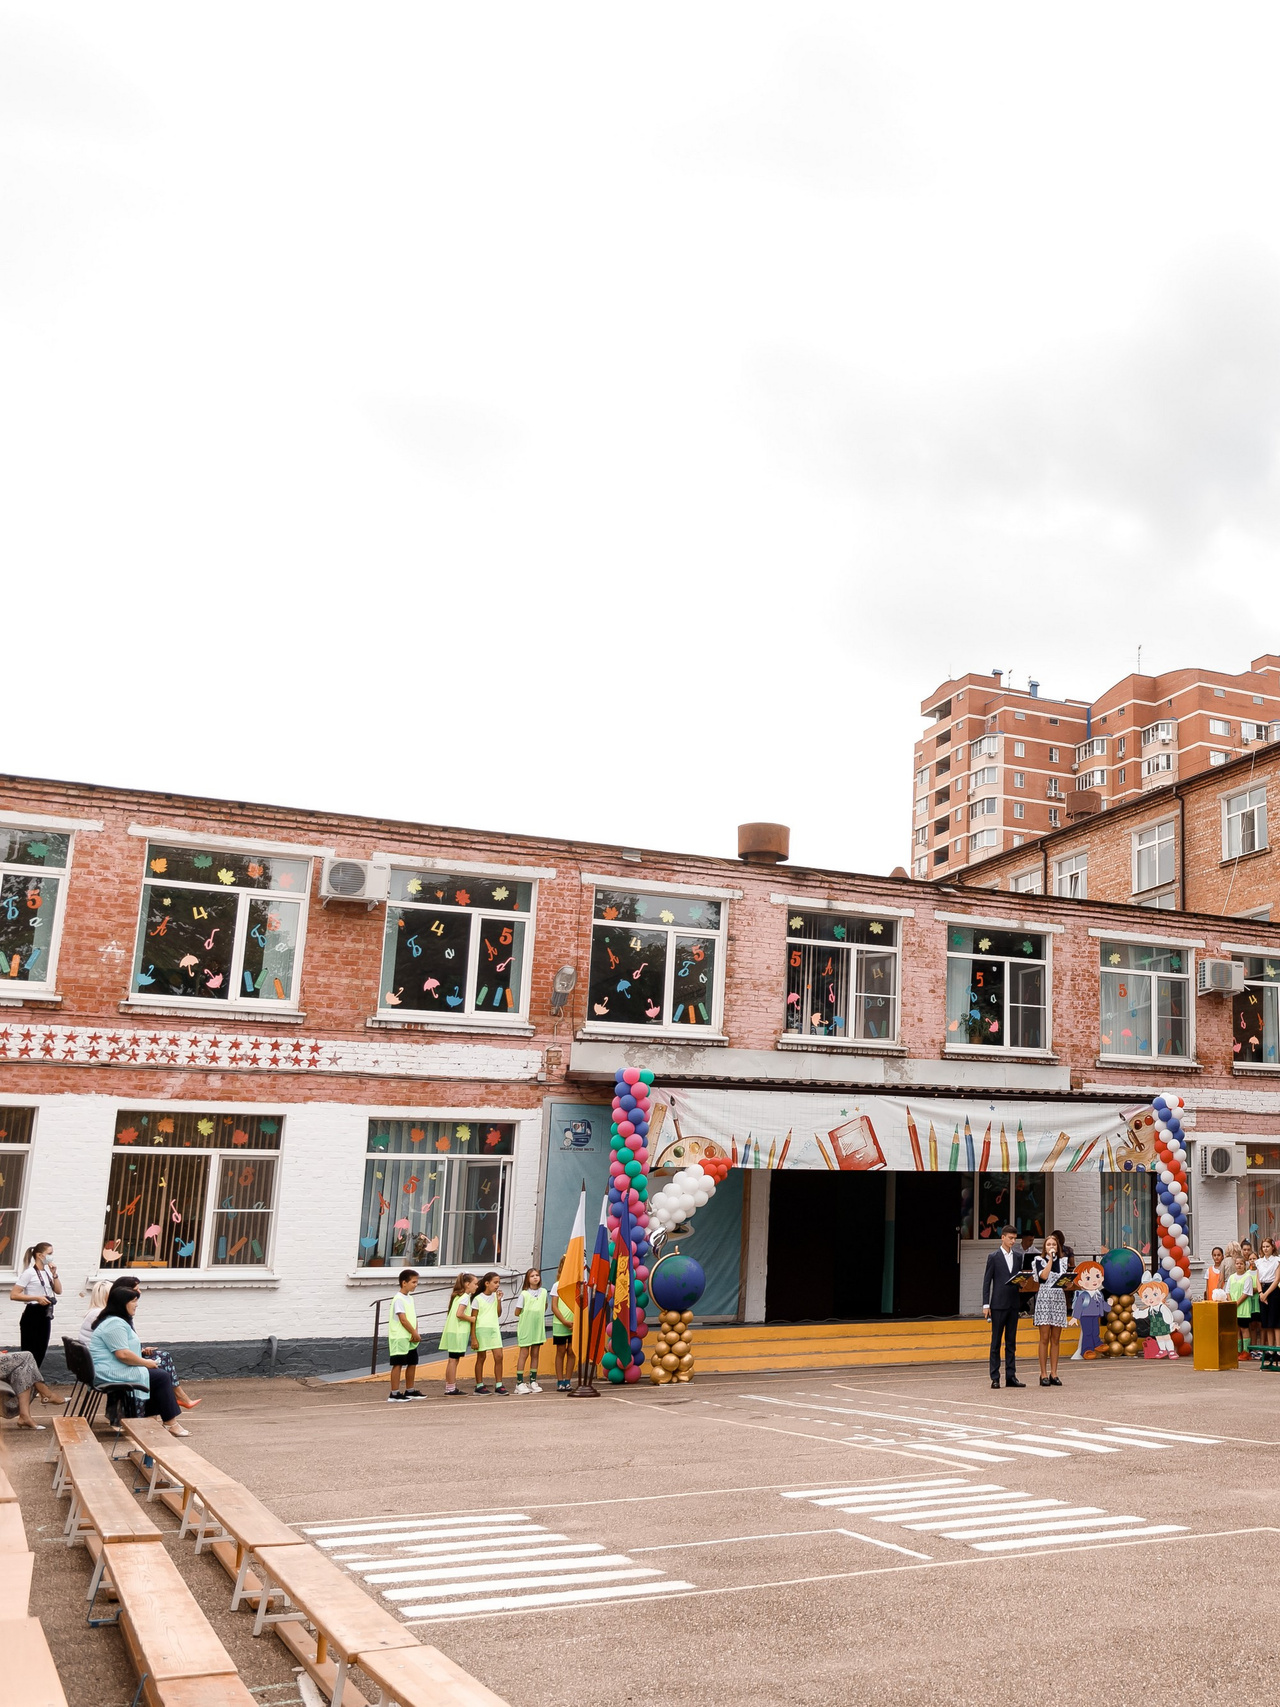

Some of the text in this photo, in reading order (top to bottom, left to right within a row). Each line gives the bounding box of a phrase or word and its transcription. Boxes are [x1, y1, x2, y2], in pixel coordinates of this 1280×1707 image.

[27, 889, 43, 909] 5
[192, 906, 209, 920] 4
[431, 920, 445, 936] 4
[500, 927, 513, 945] 5
[629, 937, 642, 952] 4
[691, 945, 705, 961] 5
[790, 951, 801, 967] 5
[1118, 984, 1127, 997] 5
[403, 1175, 420, 1194] 5
[481, 1179, 491, 1195] 4
[1123, 1183, 1131, 1196] 4
